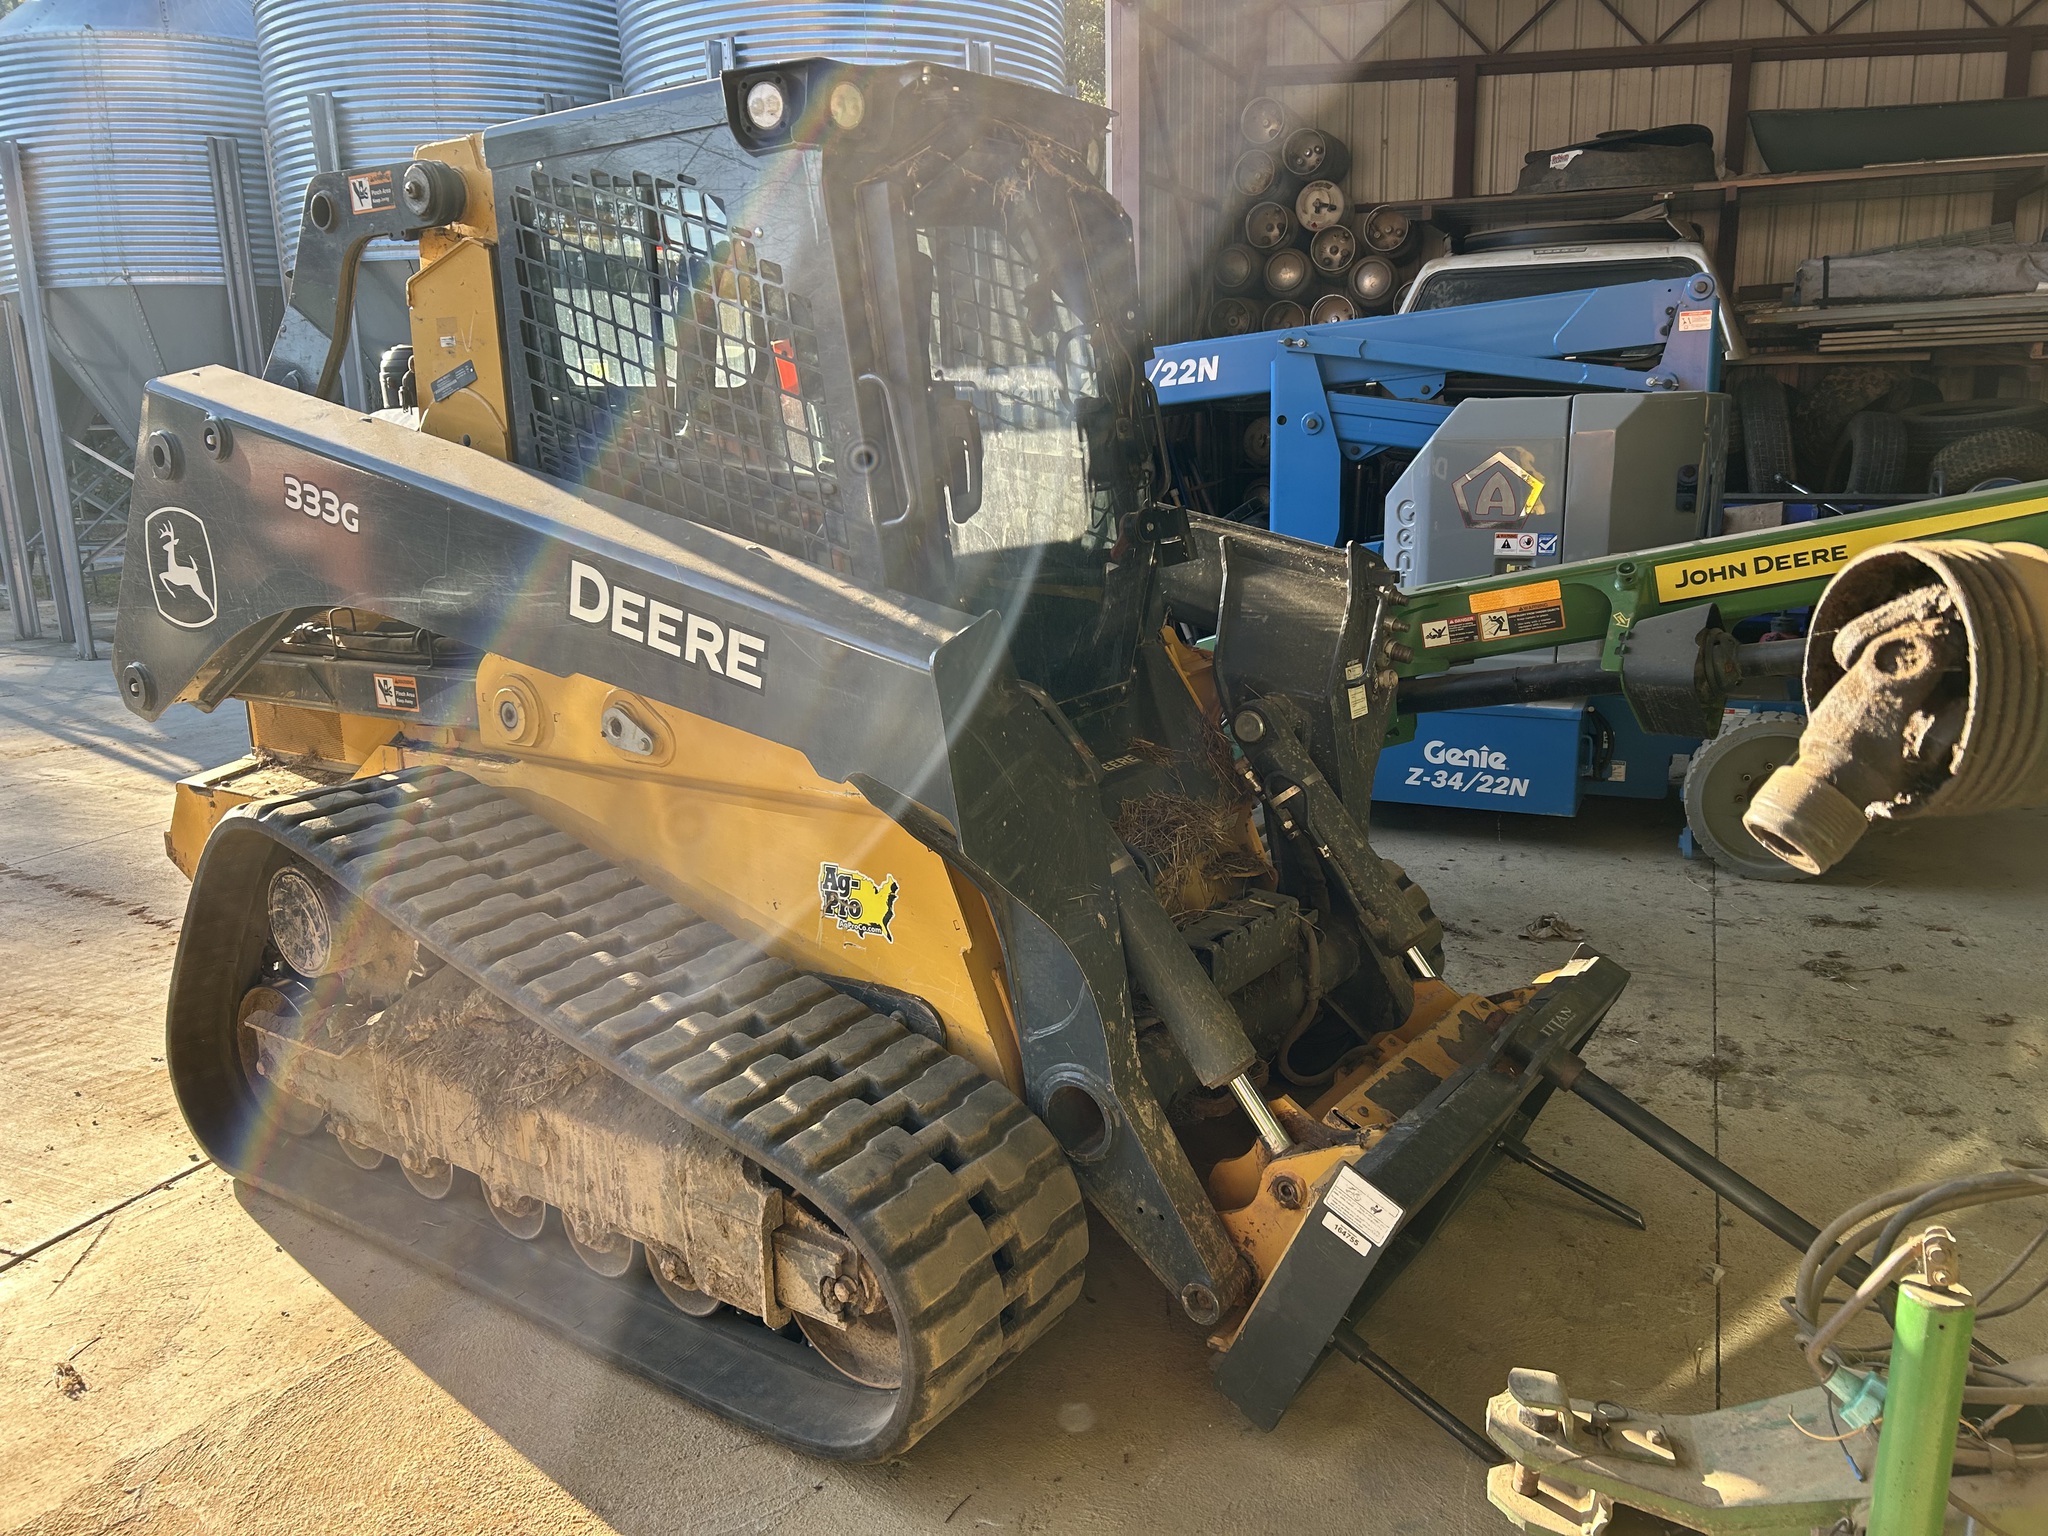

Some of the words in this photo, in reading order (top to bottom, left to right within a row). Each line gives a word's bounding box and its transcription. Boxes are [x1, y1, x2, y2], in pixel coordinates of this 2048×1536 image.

[284, 476, 359, 533] 333G
[1675, 562, 1747, 589] JOHN
[1753, 544, 1848, 575] DEERE
[569, 559, 765, 690] DEERE
[1101, 754, 1140, 772] EERE
[1423, 740, 1507, 771] Genie
[1405, 767, 1530, 797] Z-34/22N
[824, 890, 863, 919] Pro
[1540, 1006, 1572, 1037] TITAN
[1333, 1223, 1360, 1247] 164755
